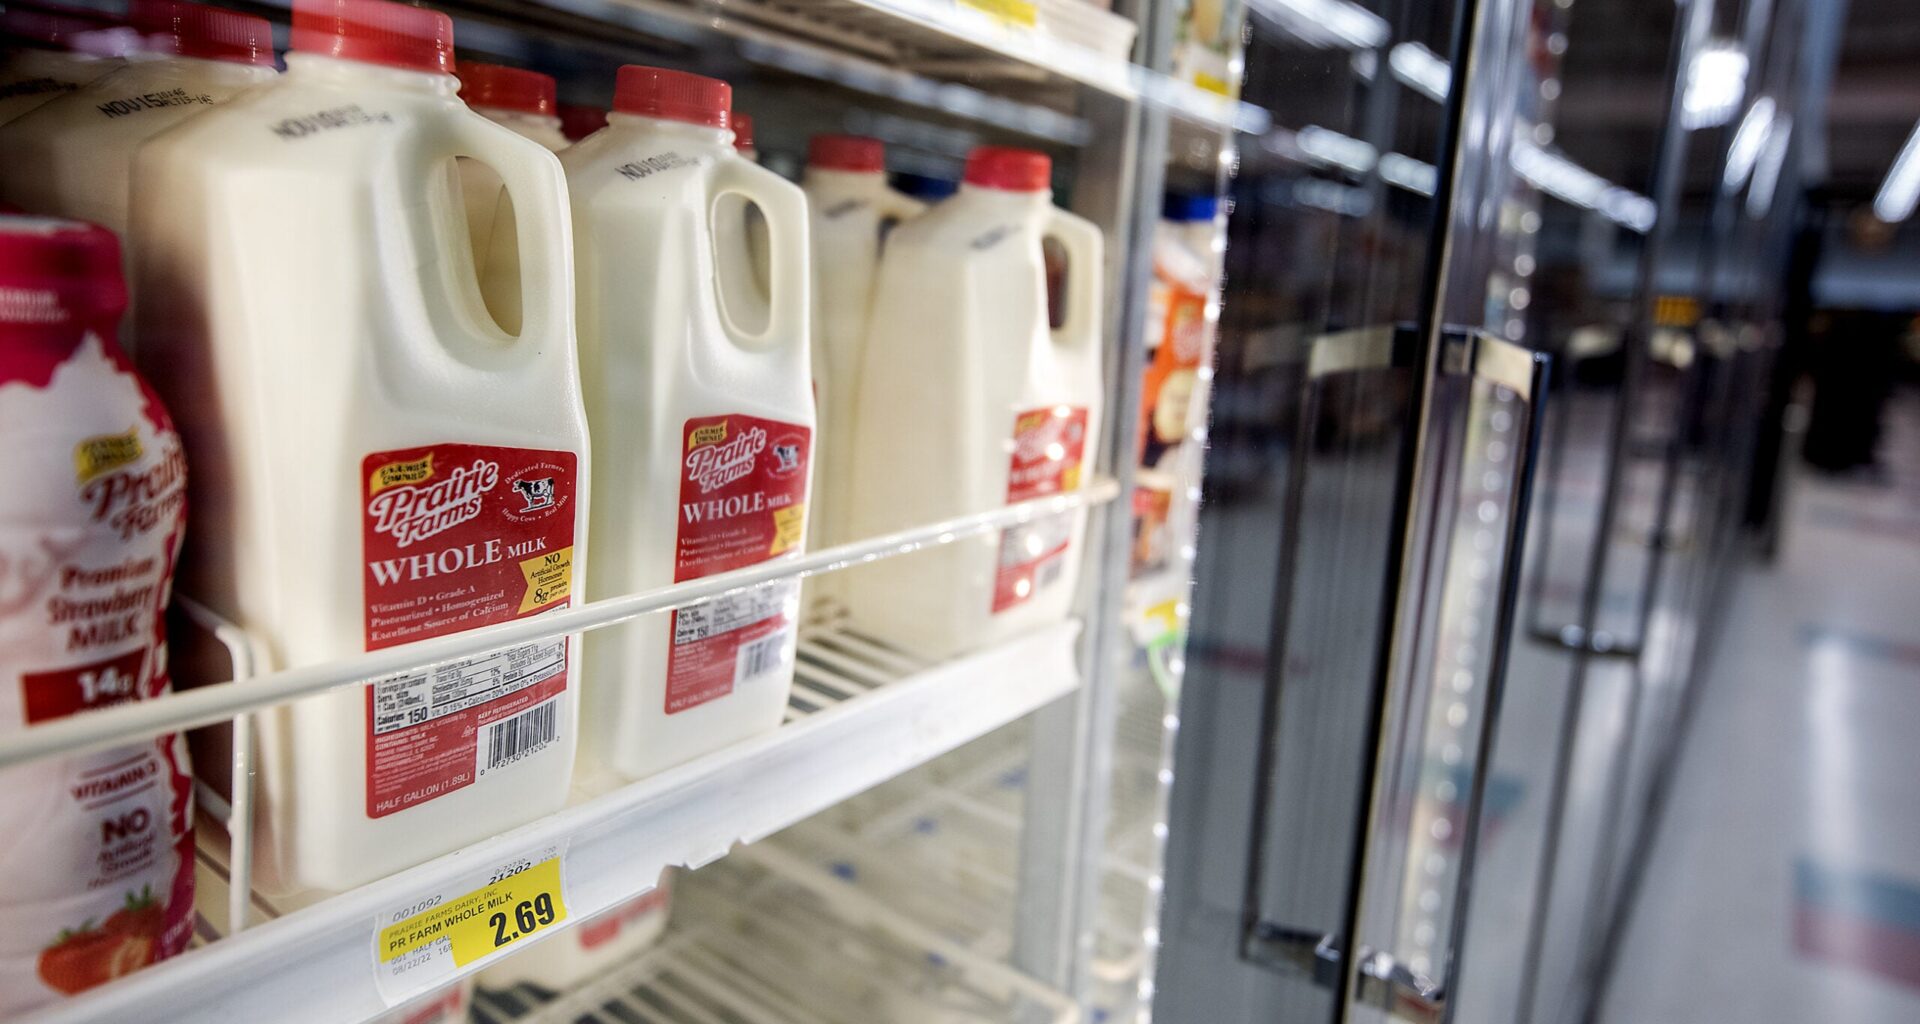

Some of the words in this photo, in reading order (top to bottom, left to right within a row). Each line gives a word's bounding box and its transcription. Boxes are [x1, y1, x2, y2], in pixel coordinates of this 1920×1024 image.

[686, 427, 766, 481] Prairie
[505, 464, 538, 484] Dedicated
[540, 462, 564, 472] Farmers
[700, 456, 755, 494] Farms
[368, 459, 499, 533] Prairie
[502, 508, 518, 522] Happy
[545, 506, 557, 517] Real
[556, 496, 568, 508] Milk
[683, 492, 765, 524] WHOLE
[767, 494, 791, 510] MILK
[392, 497, 482, 548] Farms
[369, 539, 502, 587] WHOLE
[507, 536, 547, 559] MILK
[530, 566, 552, 579] Artificial
[553, 560, 570, 570] Growth
[544, 552, 560, 566] NO
[49, 583, 152, 625] Strawberry
[371, 599, 415, 614] Vitamin
[417, 596, 427, 605] D
[436, 588, 466, 600] Grade
[467, 585, 475, 593] A
[534, 588, 549, 604] 8g
[550, 581, 567, 592] protein
[371, 608, 433, 628] Pasteurized
[442, 590, 504, 612] Homogenized
[371, 623, 422, 641] Excellent
[424, 616, 457, 629] Source
[459, 611, 469, 620] of
[472, 602, 508, 616] Calcium
[378, 713, 404, 725] Calories
[408, 706, 427, 724] 150
[492, 696, 528, 714] REFRIGERATED
[496, 754, 521, 769] 72730
[376, 796, 401, 812] HALF
[403, 784, 439, 802] GALLON
[442, 772, 470, 790] (1.89L)
[102, 807, 150, 844] NO
[488, 862, 531, 886] 21202
[389, 921, 422, 938] PRAIRIE
[426, 907, 452, 924] FARMS
[454, 895, 481, 912] DAIRY,
[484, 888, 498, 900] INC
[389, 936, 406, 951] PR
[409, 922, 442, 942] FARM
[444, 904, 484, 927] WHOLE
[488, 892, 513, 909] MILK
[393, 896, 442, 922] 001092
[489, 892, 555, 947] 2.69
[413, 940, 433, 955] HALF
[435, 935, 451, 945] GAL
[393, 953, 431, 975] 08/22/22
